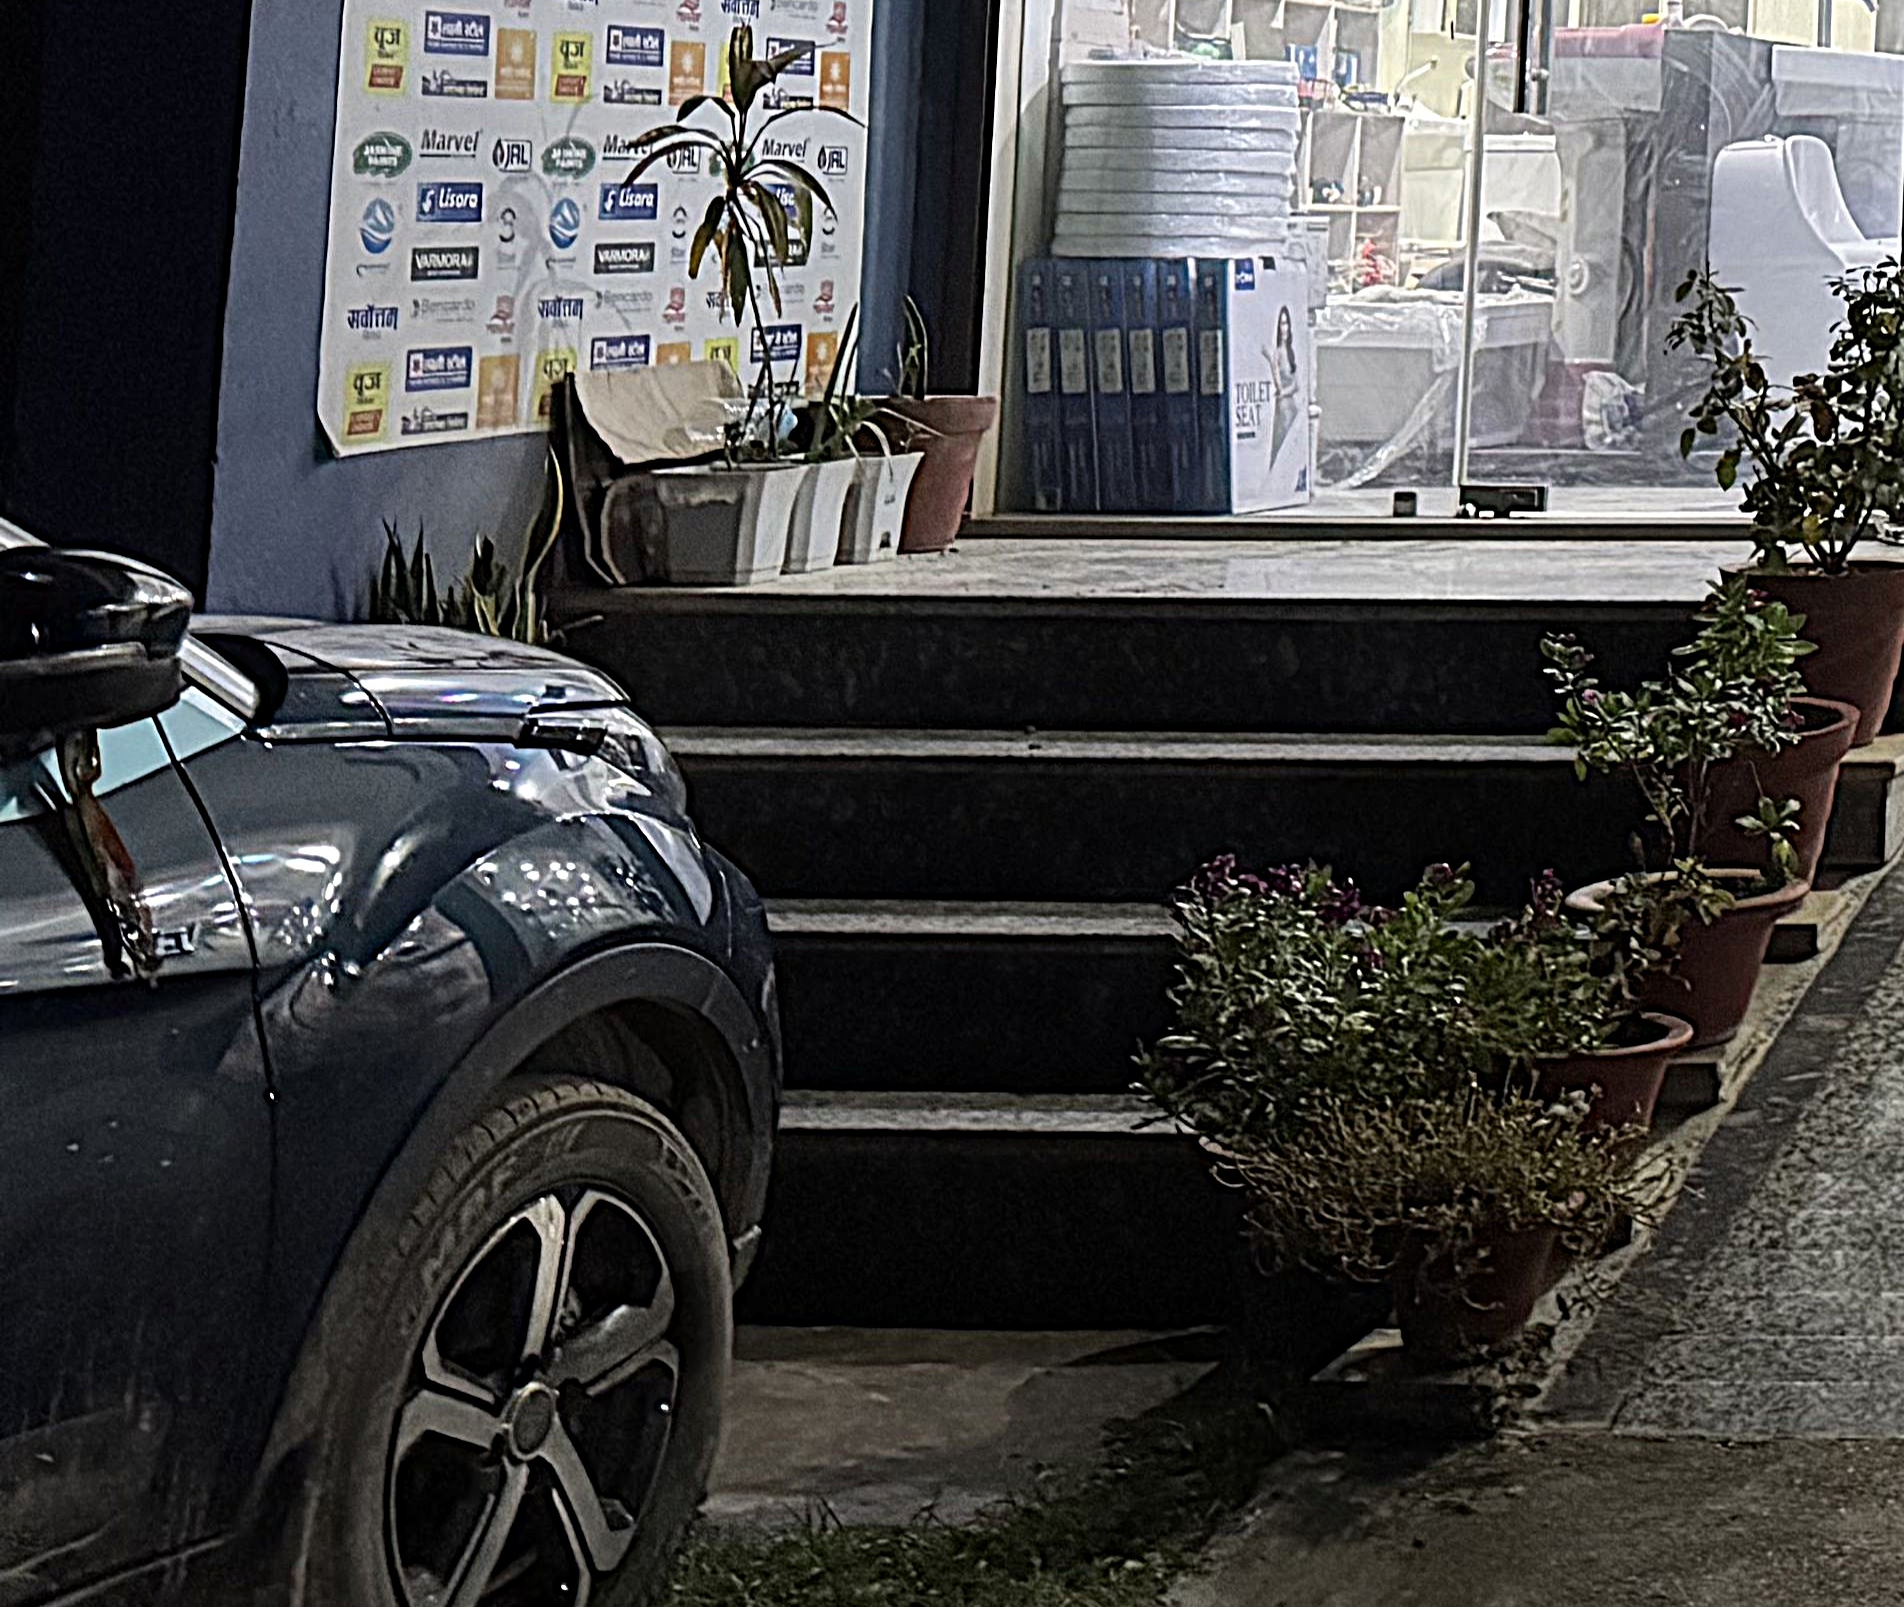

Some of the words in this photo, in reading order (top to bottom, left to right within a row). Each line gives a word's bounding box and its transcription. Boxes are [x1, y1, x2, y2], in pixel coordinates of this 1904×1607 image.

[421, 129, 479, 152] Marvel
[762, 139, 807, 157] Marvel
[438, 187, 478, 209] Lisora
[619, 188, 654, 208] Lisora
[1235, 380, 1271, 403] TOILET
[1236, 404, 1261, 427] SEAT
